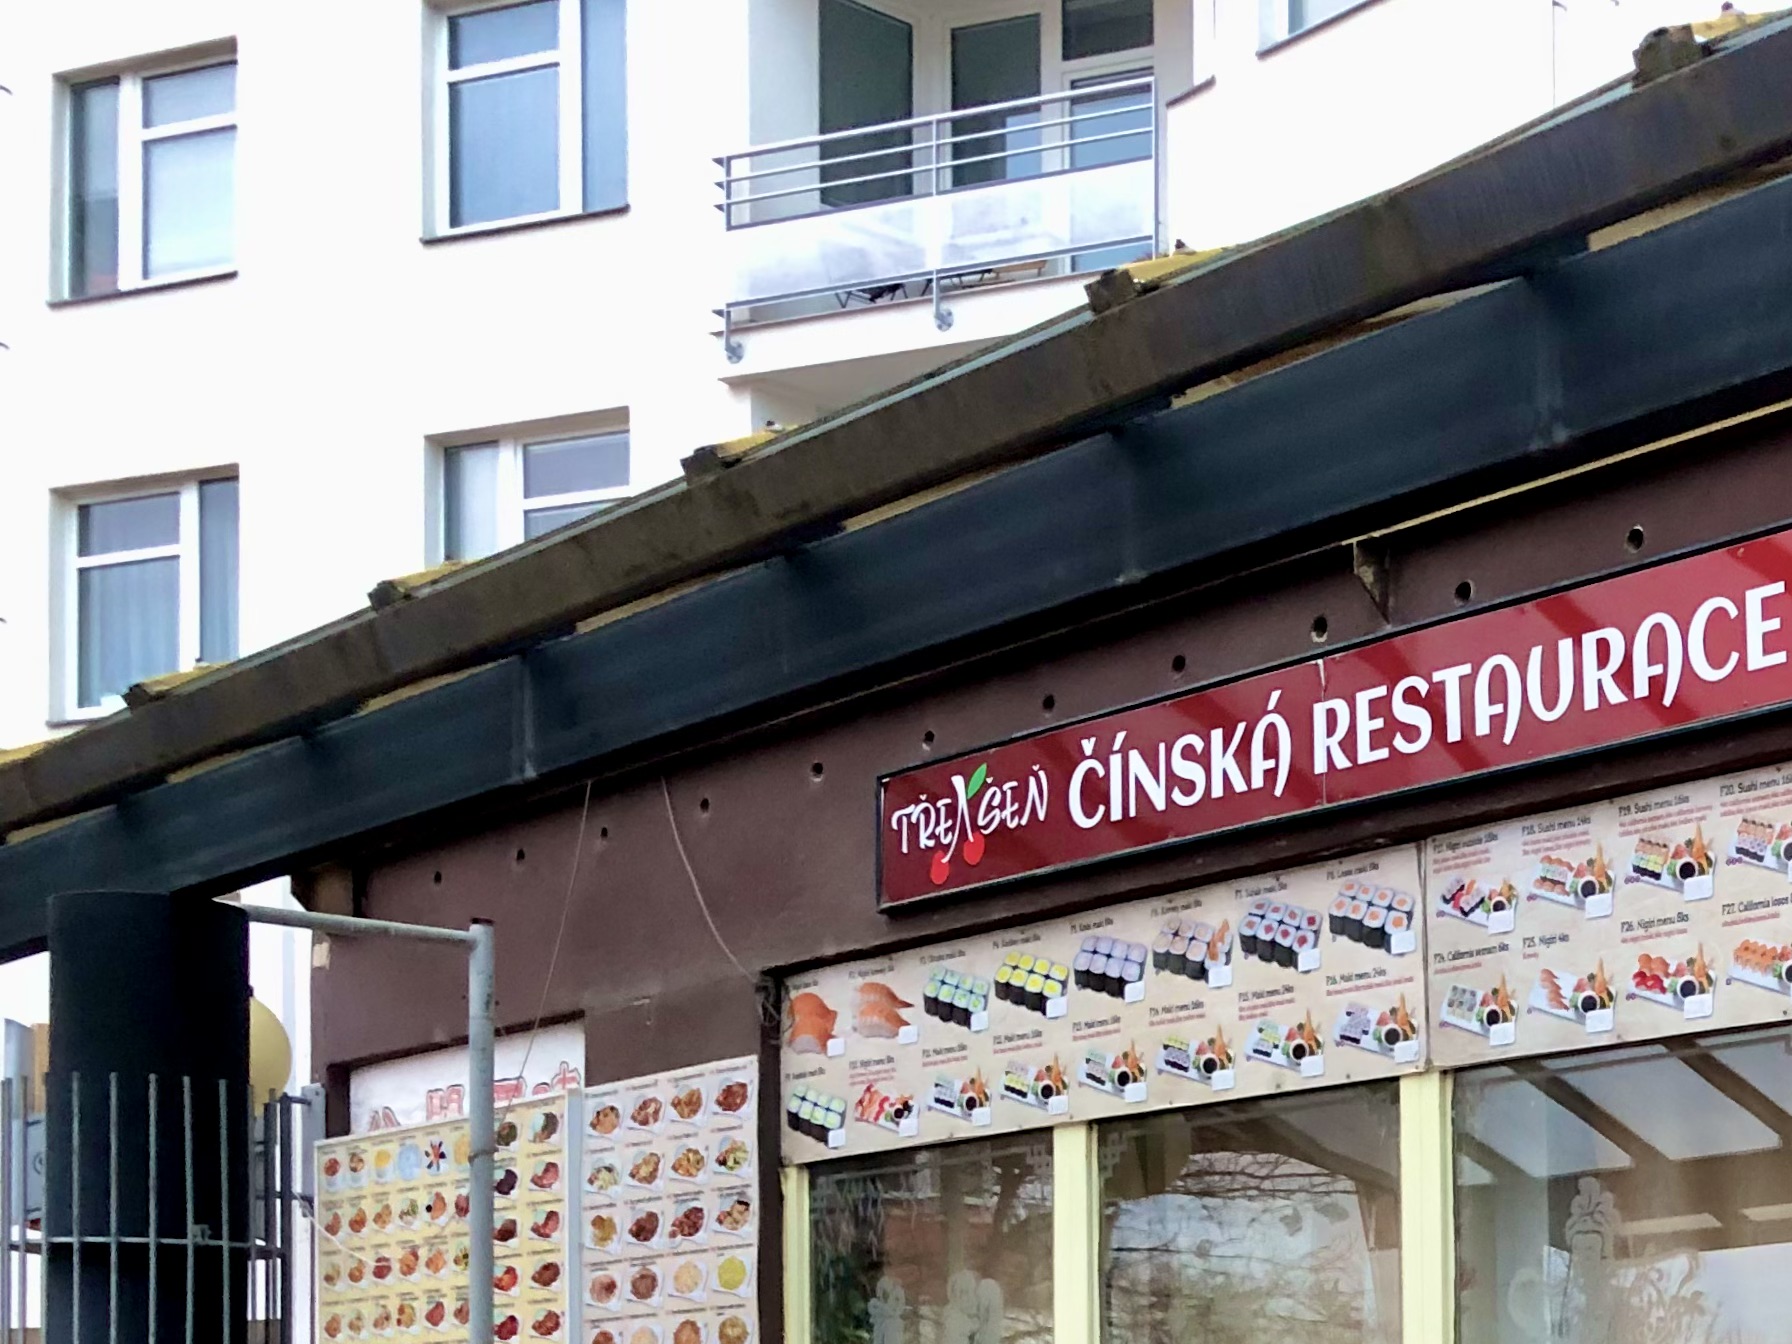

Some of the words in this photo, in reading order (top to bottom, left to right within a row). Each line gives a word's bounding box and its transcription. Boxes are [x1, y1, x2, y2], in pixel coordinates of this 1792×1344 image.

[1068, 688, 1292, 829] ČÍNSKÁ
[1312, 580, 1788, 775] RESTAURACE
[1737, 778, 1757, 794] Sushi
[1759, 776, 1779, 789] menu
